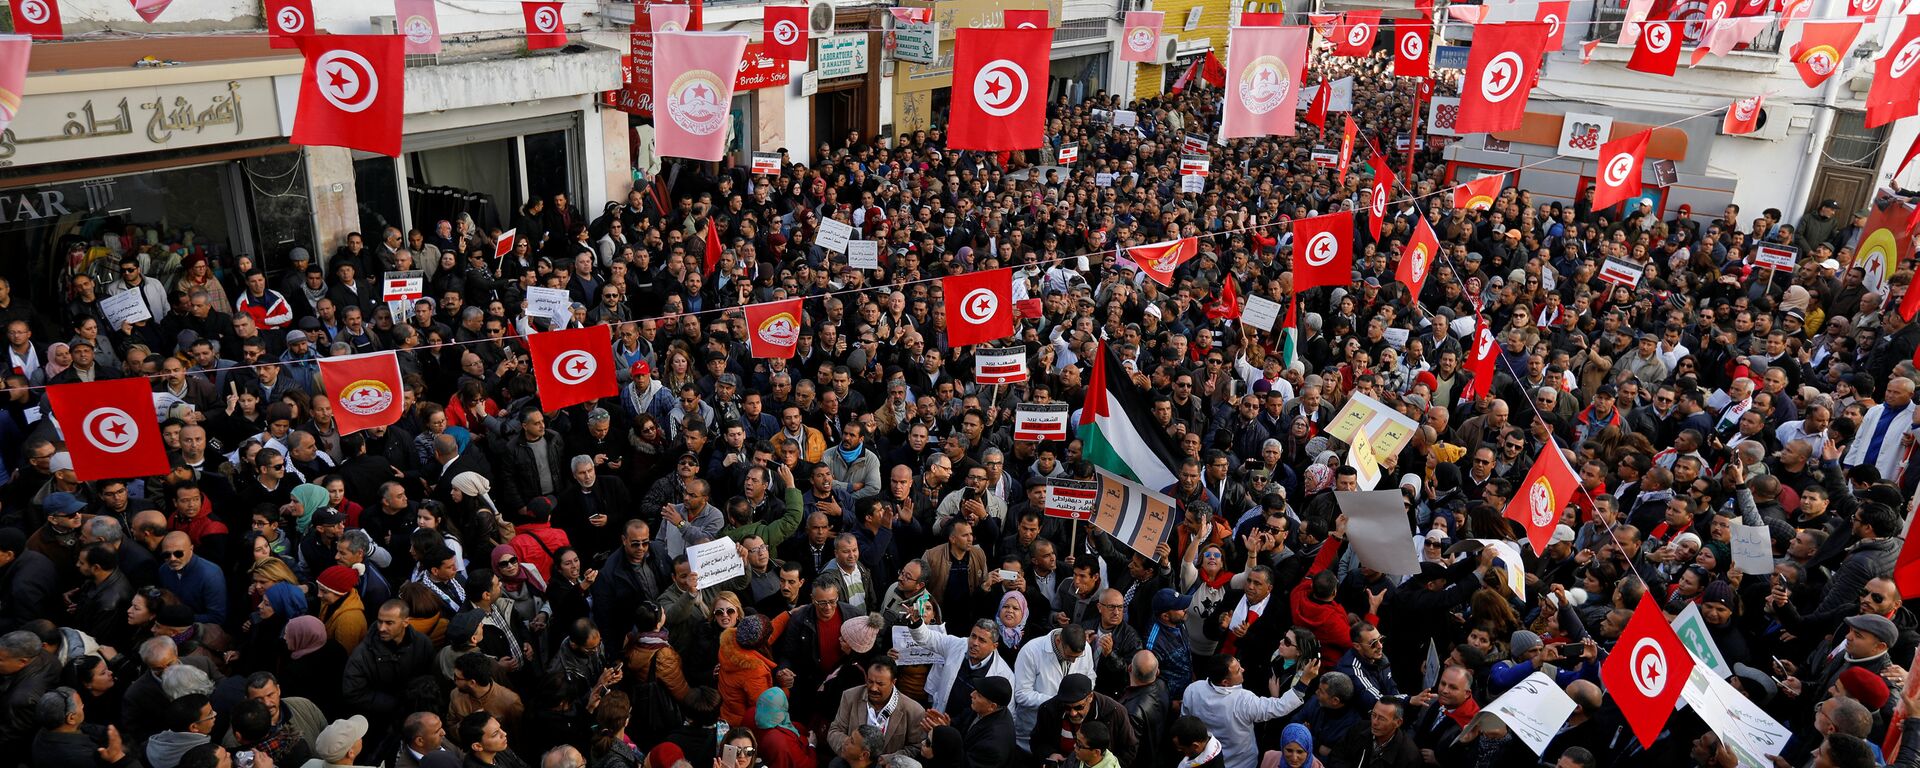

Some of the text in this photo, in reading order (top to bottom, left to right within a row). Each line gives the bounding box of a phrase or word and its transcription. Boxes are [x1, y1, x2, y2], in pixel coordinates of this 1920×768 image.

[820, 50, 853, 61] LABORATOIRE
[1349, 412, 1365, 420] نعم
[1385, 431, 1402, 440] نعم
[1106, 489, 1120, 499] نعم
[1149, 511, 1165, 522] نعم
